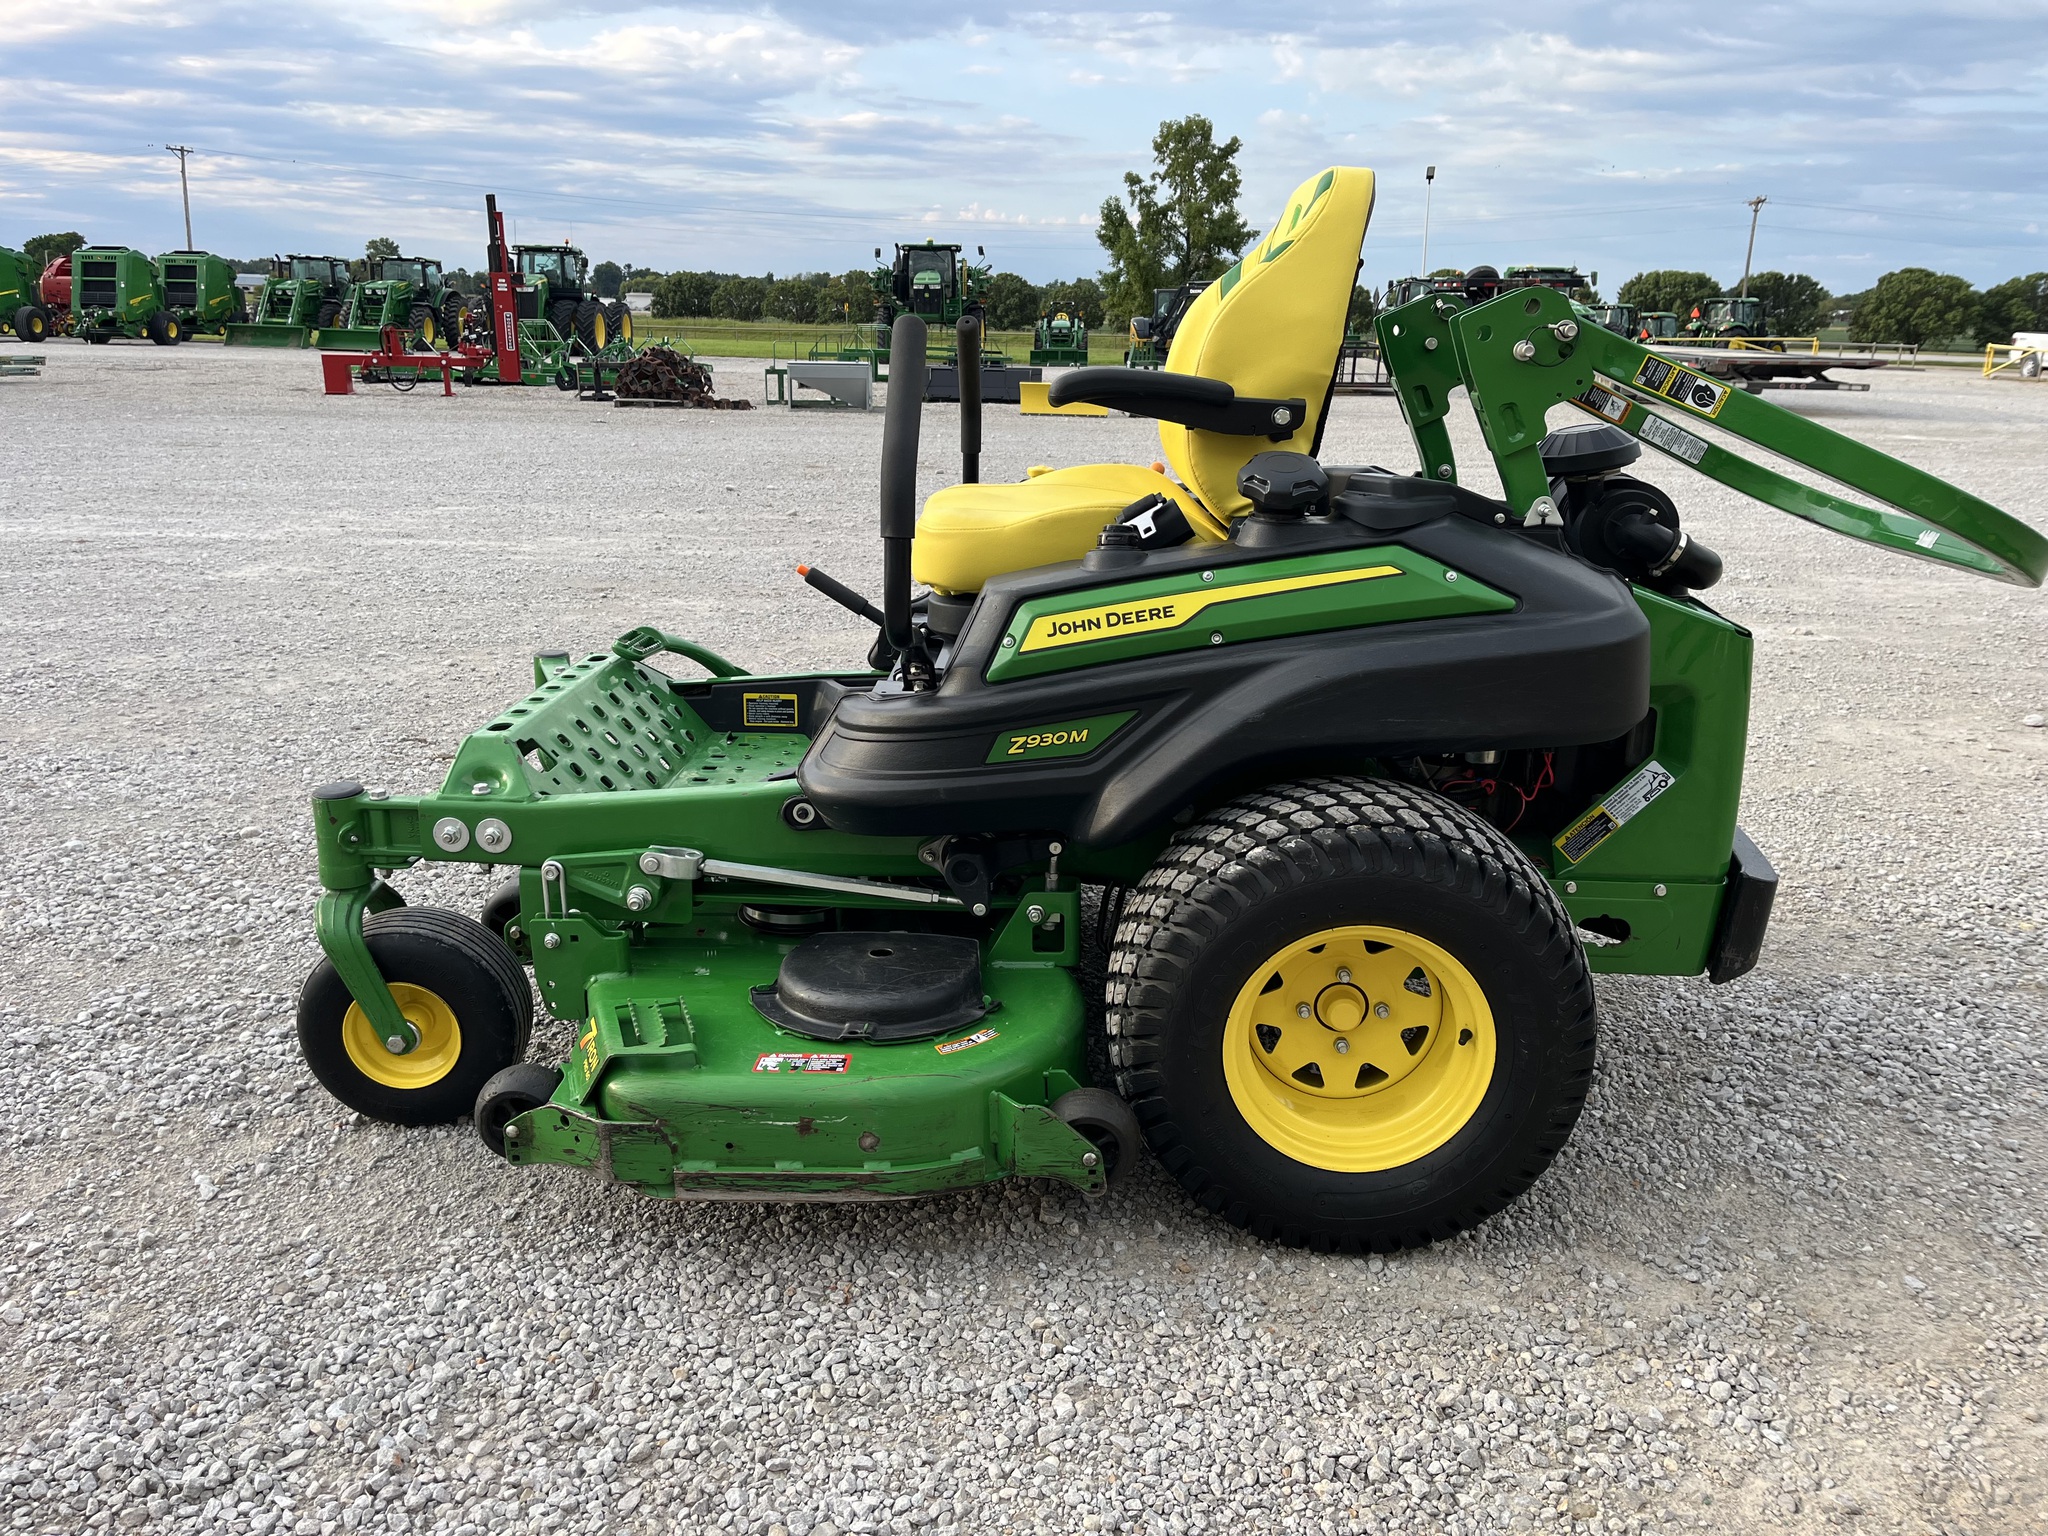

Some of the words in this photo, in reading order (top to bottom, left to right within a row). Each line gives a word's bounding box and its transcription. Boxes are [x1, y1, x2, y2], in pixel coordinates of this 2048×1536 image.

[1712, 394, 1727, 416] CAUTION
[1047, 617, 1102, 638] JOHN
[1105, 605, 1176, 628] DEERE
[1007, 729, 1089, 755] Z930M
